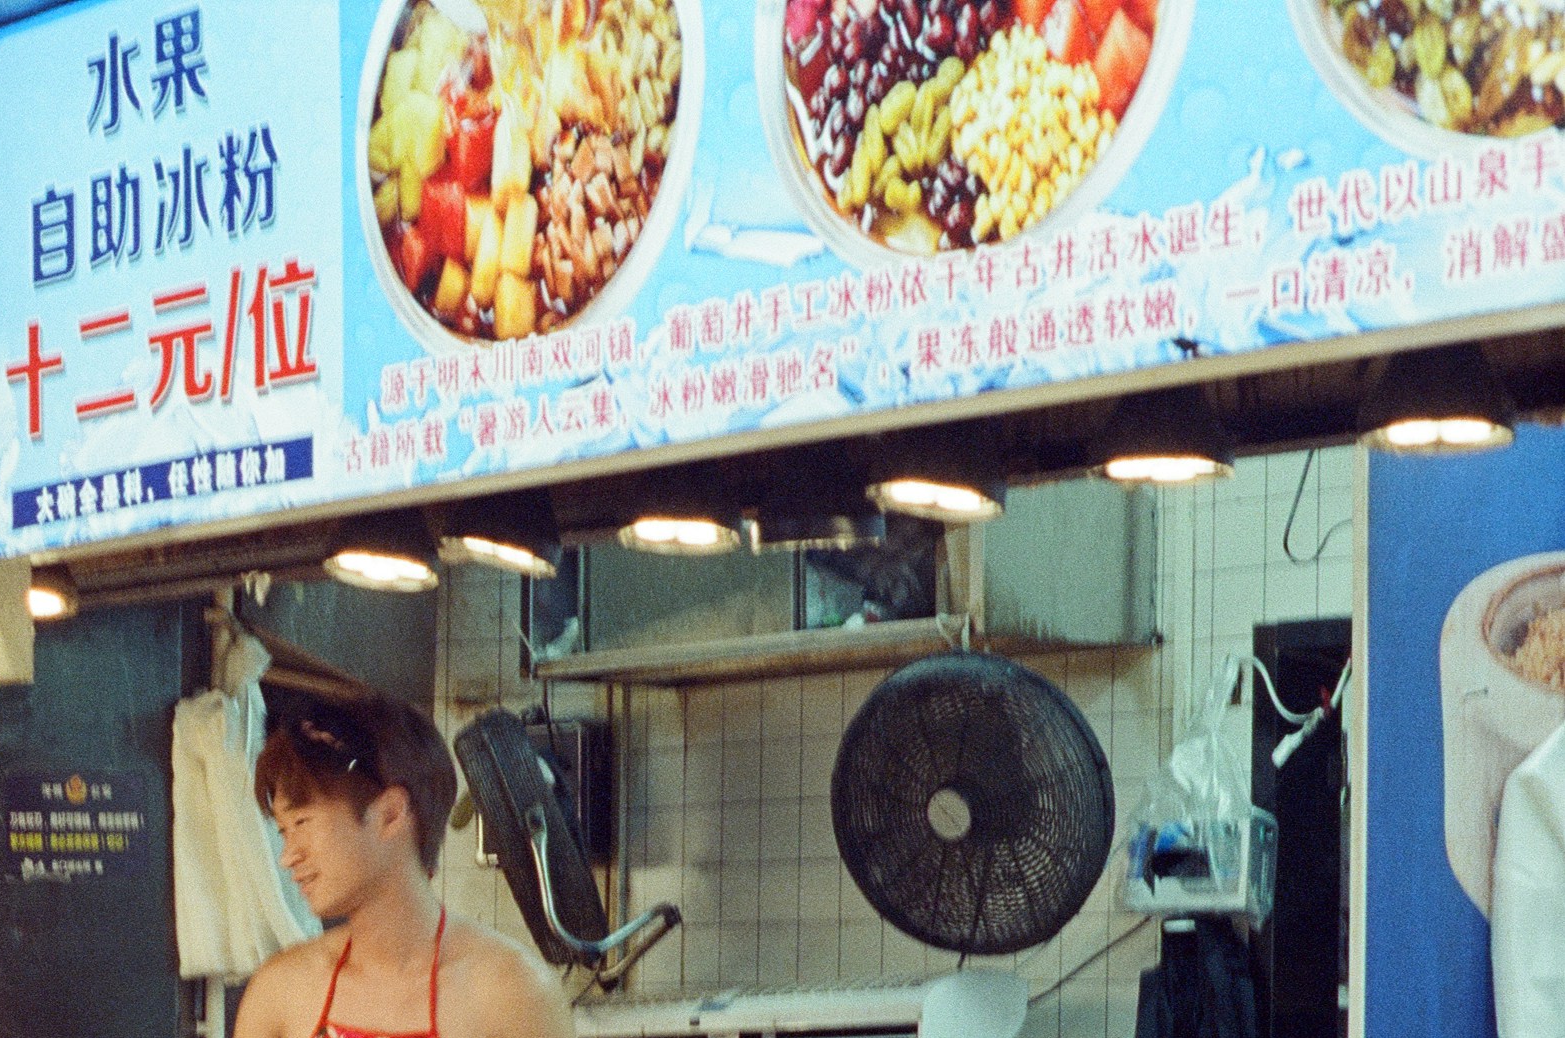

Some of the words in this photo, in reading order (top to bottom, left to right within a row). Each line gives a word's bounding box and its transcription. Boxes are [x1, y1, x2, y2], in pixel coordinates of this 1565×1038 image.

[87, 5, 209, 136] 水果
[32, 125, 279, 282] 自助冰粉
[7, 258, 317, 440] 十二元/位
